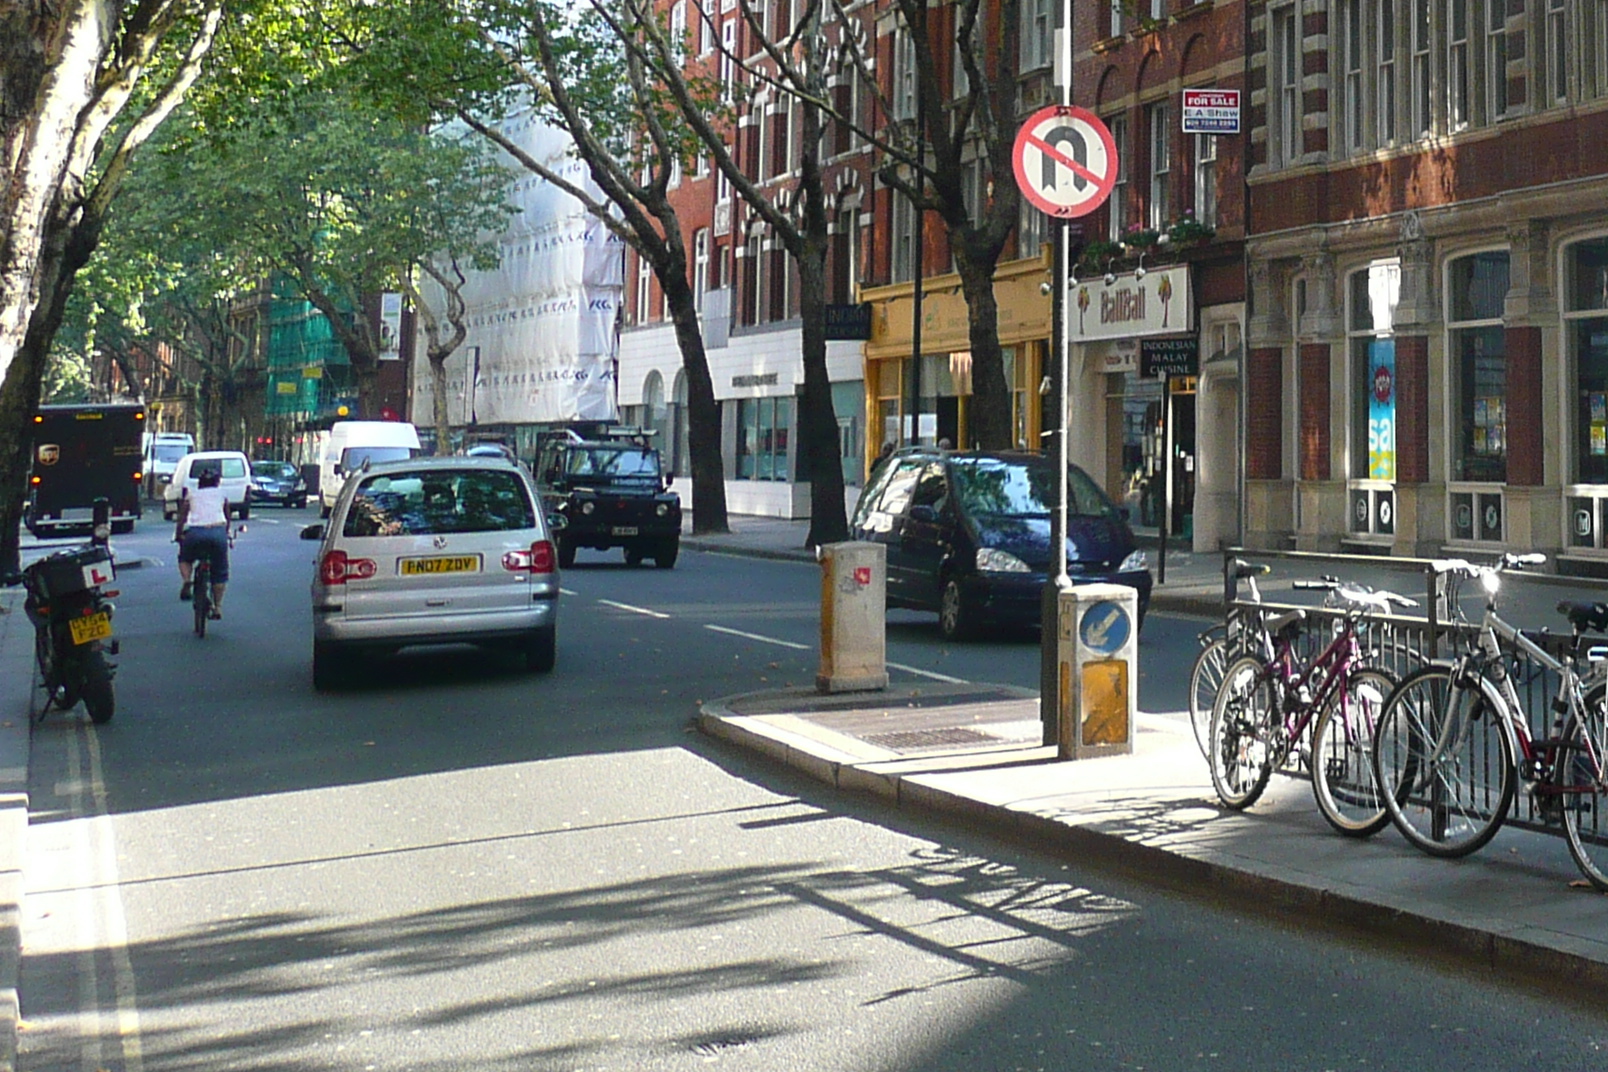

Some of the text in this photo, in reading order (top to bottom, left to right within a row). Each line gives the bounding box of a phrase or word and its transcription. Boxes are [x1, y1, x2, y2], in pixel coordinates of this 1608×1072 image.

[1187, 96, 1236, 106] FOR SALE
[1195, 109, 1204, 117] A
[1142, 340, 1197, 350] INDONESIAN
[1151, 353, 1188, 362] MALAY
[1149, 365, 1191, 374] CUISINE
[91, 569, 108, 585] L
